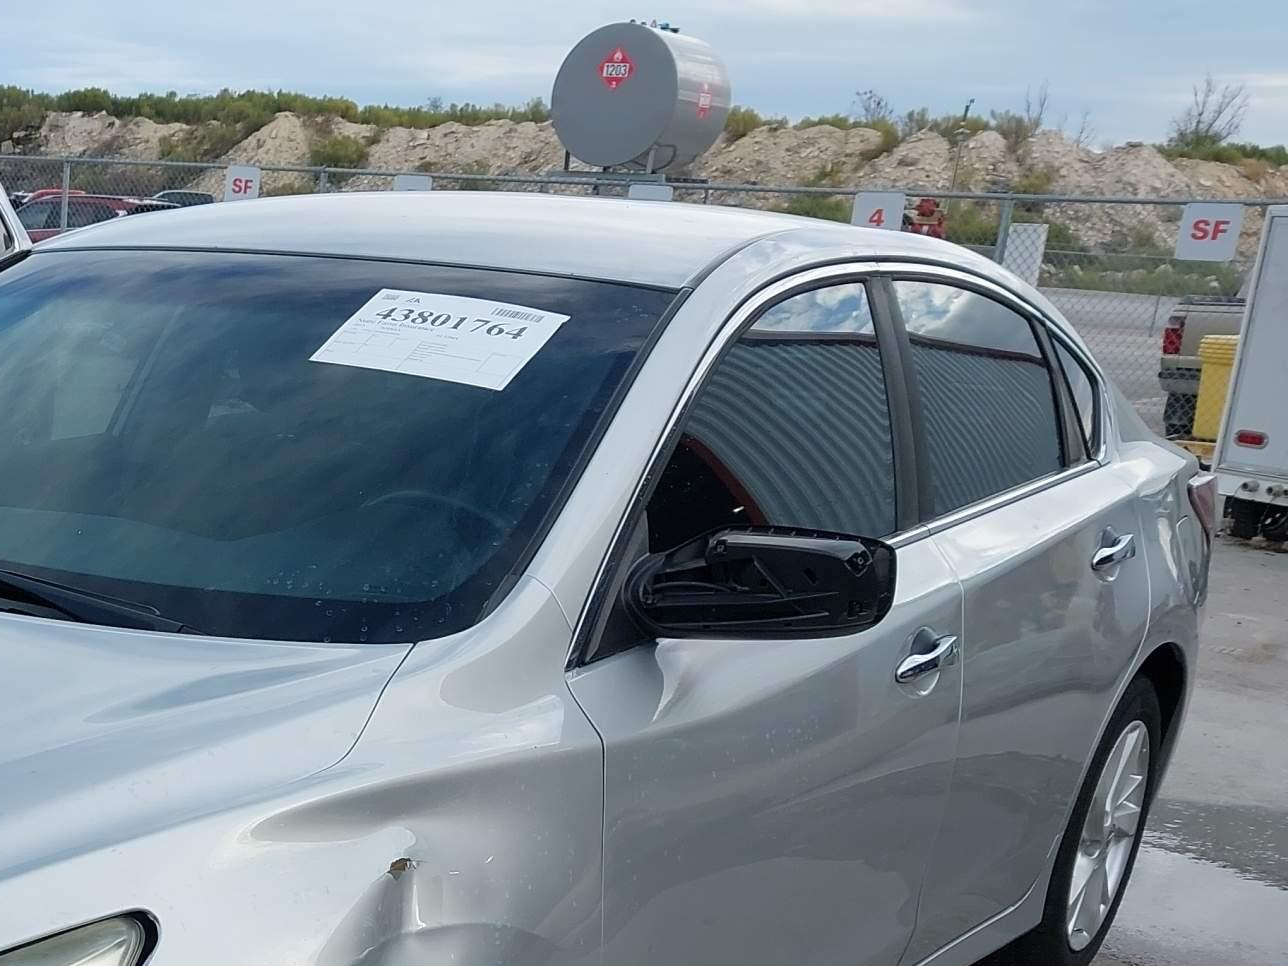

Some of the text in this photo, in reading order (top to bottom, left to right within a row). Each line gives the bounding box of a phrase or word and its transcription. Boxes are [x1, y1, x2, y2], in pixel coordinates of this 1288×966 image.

[606, 64, 628, 76] 1203
[232, 178, 253, 194] SF
[868, 208, 884, 226] 4
[1190, 219, 1231, 241] SF
[375, 306, 529, 340] 43801764
